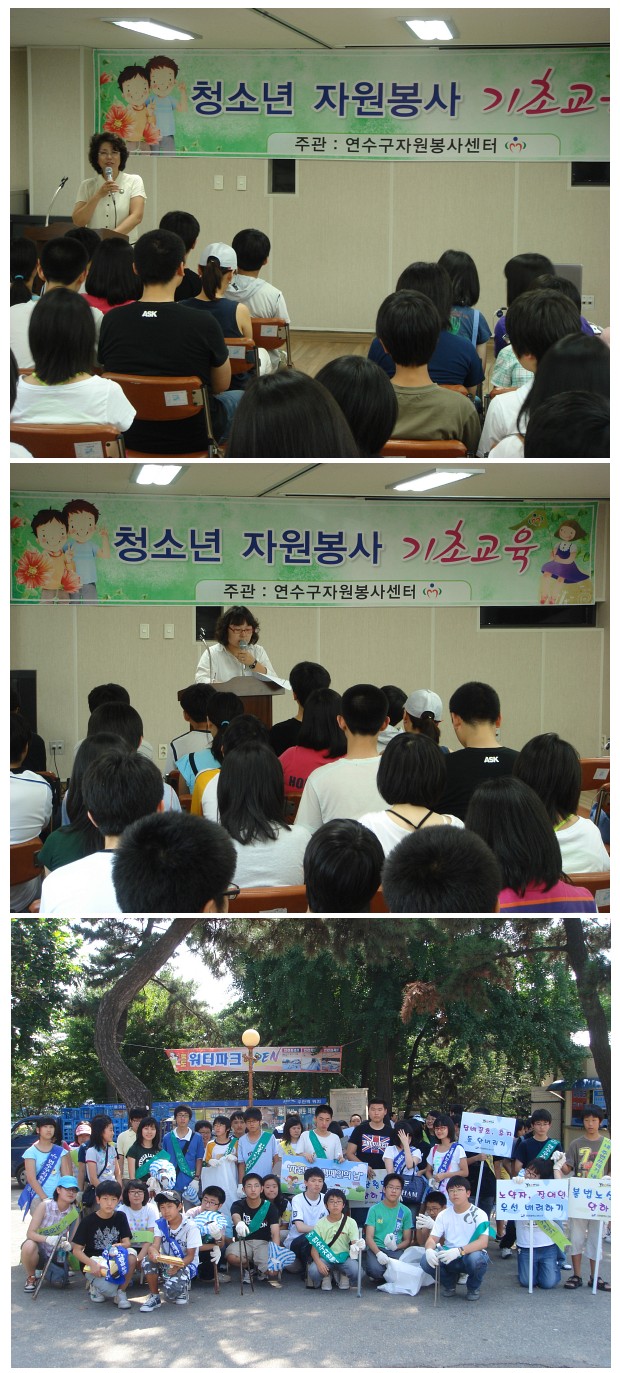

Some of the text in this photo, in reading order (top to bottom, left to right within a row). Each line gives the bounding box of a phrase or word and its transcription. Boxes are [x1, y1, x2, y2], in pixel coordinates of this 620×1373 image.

[191, 81, 293, 115] 청소년
[313, 81, 461, 117] 자원봉사
[294, 136, 327, 151] 주관
[345, 137, 497, 154] 연수구자원봉사센터
[114, 519, 540, 573] 청소년 자원봉사 기초교육
[223, 584, 256, 599] 주관
[274, 584, 416, 600] 연수구자원봉사센터
[188, 1052, 242, 1067] 워터파크
[499, 1190, 566, 1199] 노약자, 장애인
[501, 1203, 563, 1212] 우선 배려하기
[588, 1202, 608, 1212] 안하
